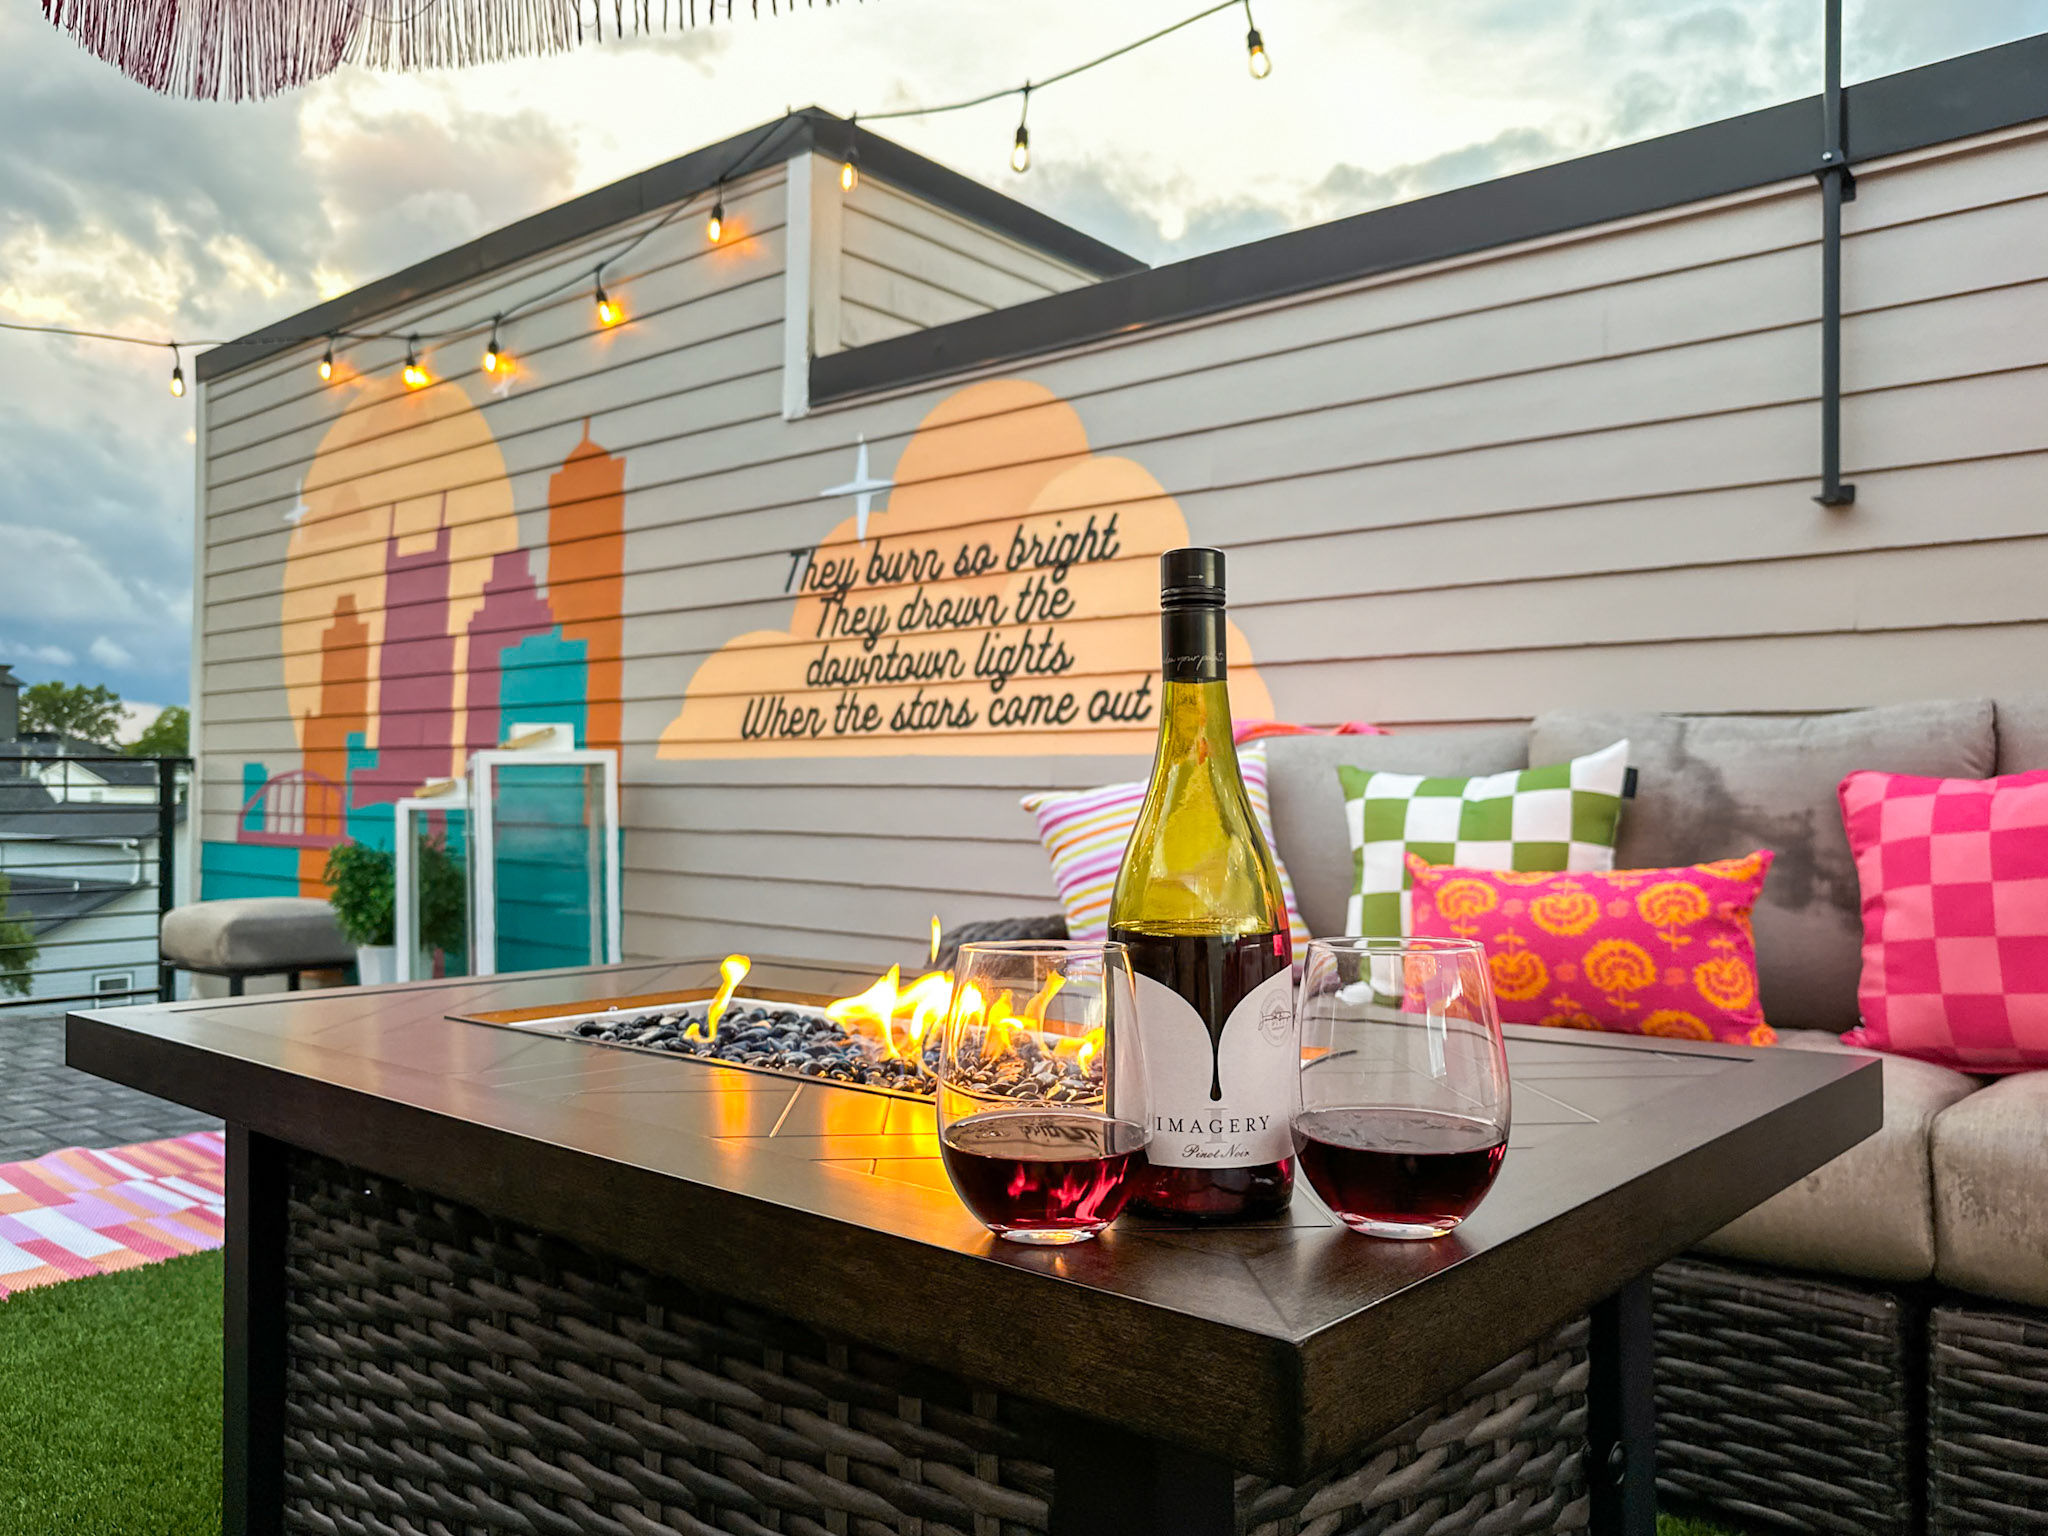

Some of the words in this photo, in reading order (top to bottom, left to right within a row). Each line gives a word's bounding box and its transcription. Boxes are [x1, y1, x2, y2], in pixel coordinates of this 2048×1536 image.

[785, 547, 859, 598] They
[866, 538, 945, 585] burn
[953, 544, 999, 577] so
[1006, 512, 1120, 584] bright
[815, 592, 891, 653] They
[897, 585, 1008, 632] drown
[1015, 575, 1076, 624] the
[806, 639, 966, 687] downtown
[974, 627, 1075, 693] lights
[741, 696, 827, 739] When
[833, 691, 883, 734] the
[890, 688, 979, 731] stars
[988, 692, 1080, 727] come
[1088, 673, 1153, 723] out
[1156, 1115, 1270, 1134] IMAGERY
[1181, 1143, 1221, 1159] Pinot
[1220, 1143, 1250, 1158] Noir
